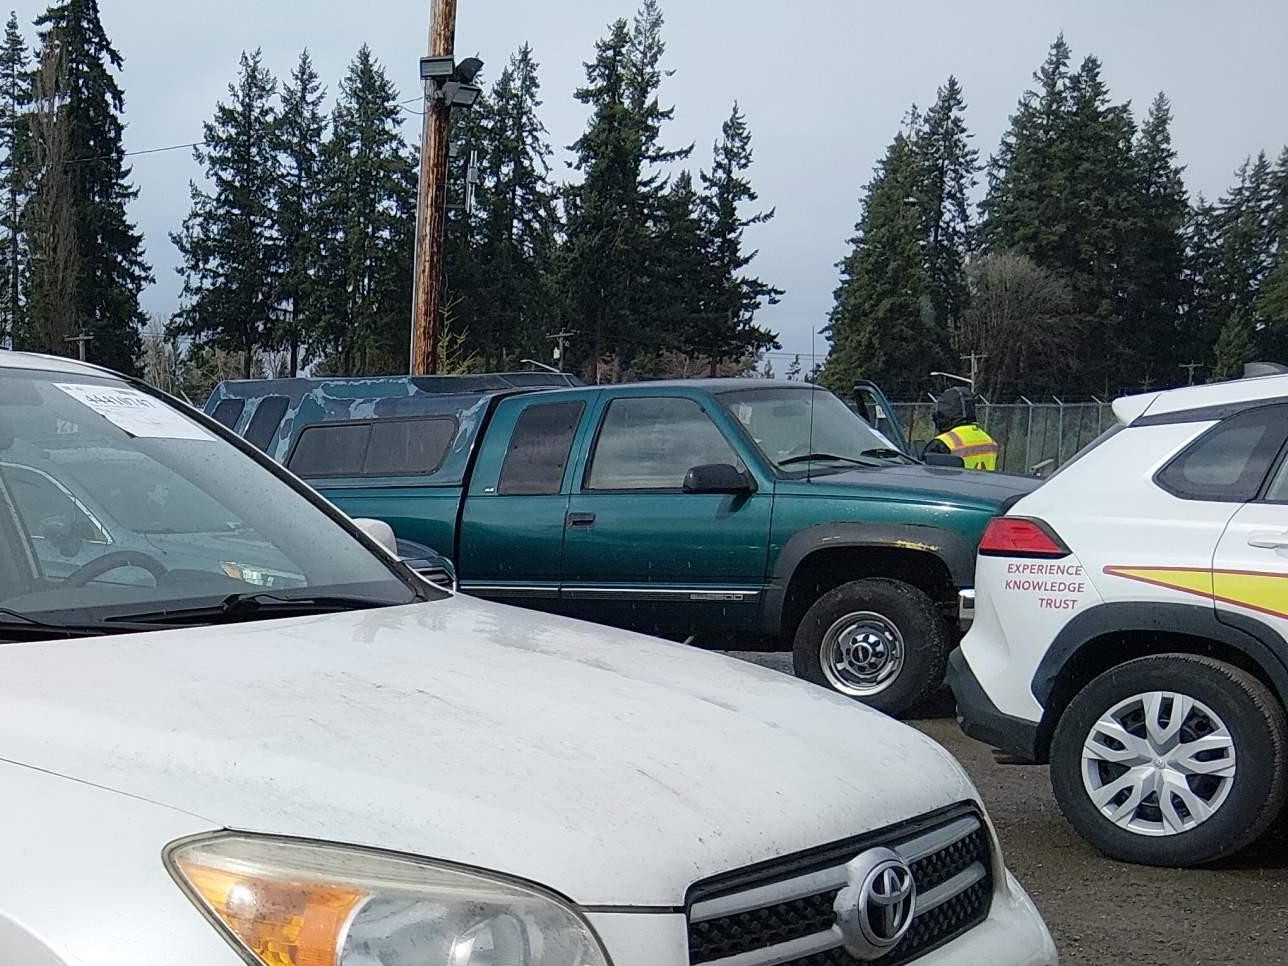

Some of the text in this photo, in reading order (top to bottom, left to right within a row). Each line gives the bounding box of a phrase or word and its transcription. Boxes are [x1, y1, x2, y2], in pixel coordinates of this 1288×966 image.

[1007, 563, 1083, 576] EXPERIENCE
[1004, 580, 1086, 593] KNOWLEDGE
[1038, 598, 1079, 610] TRUST
